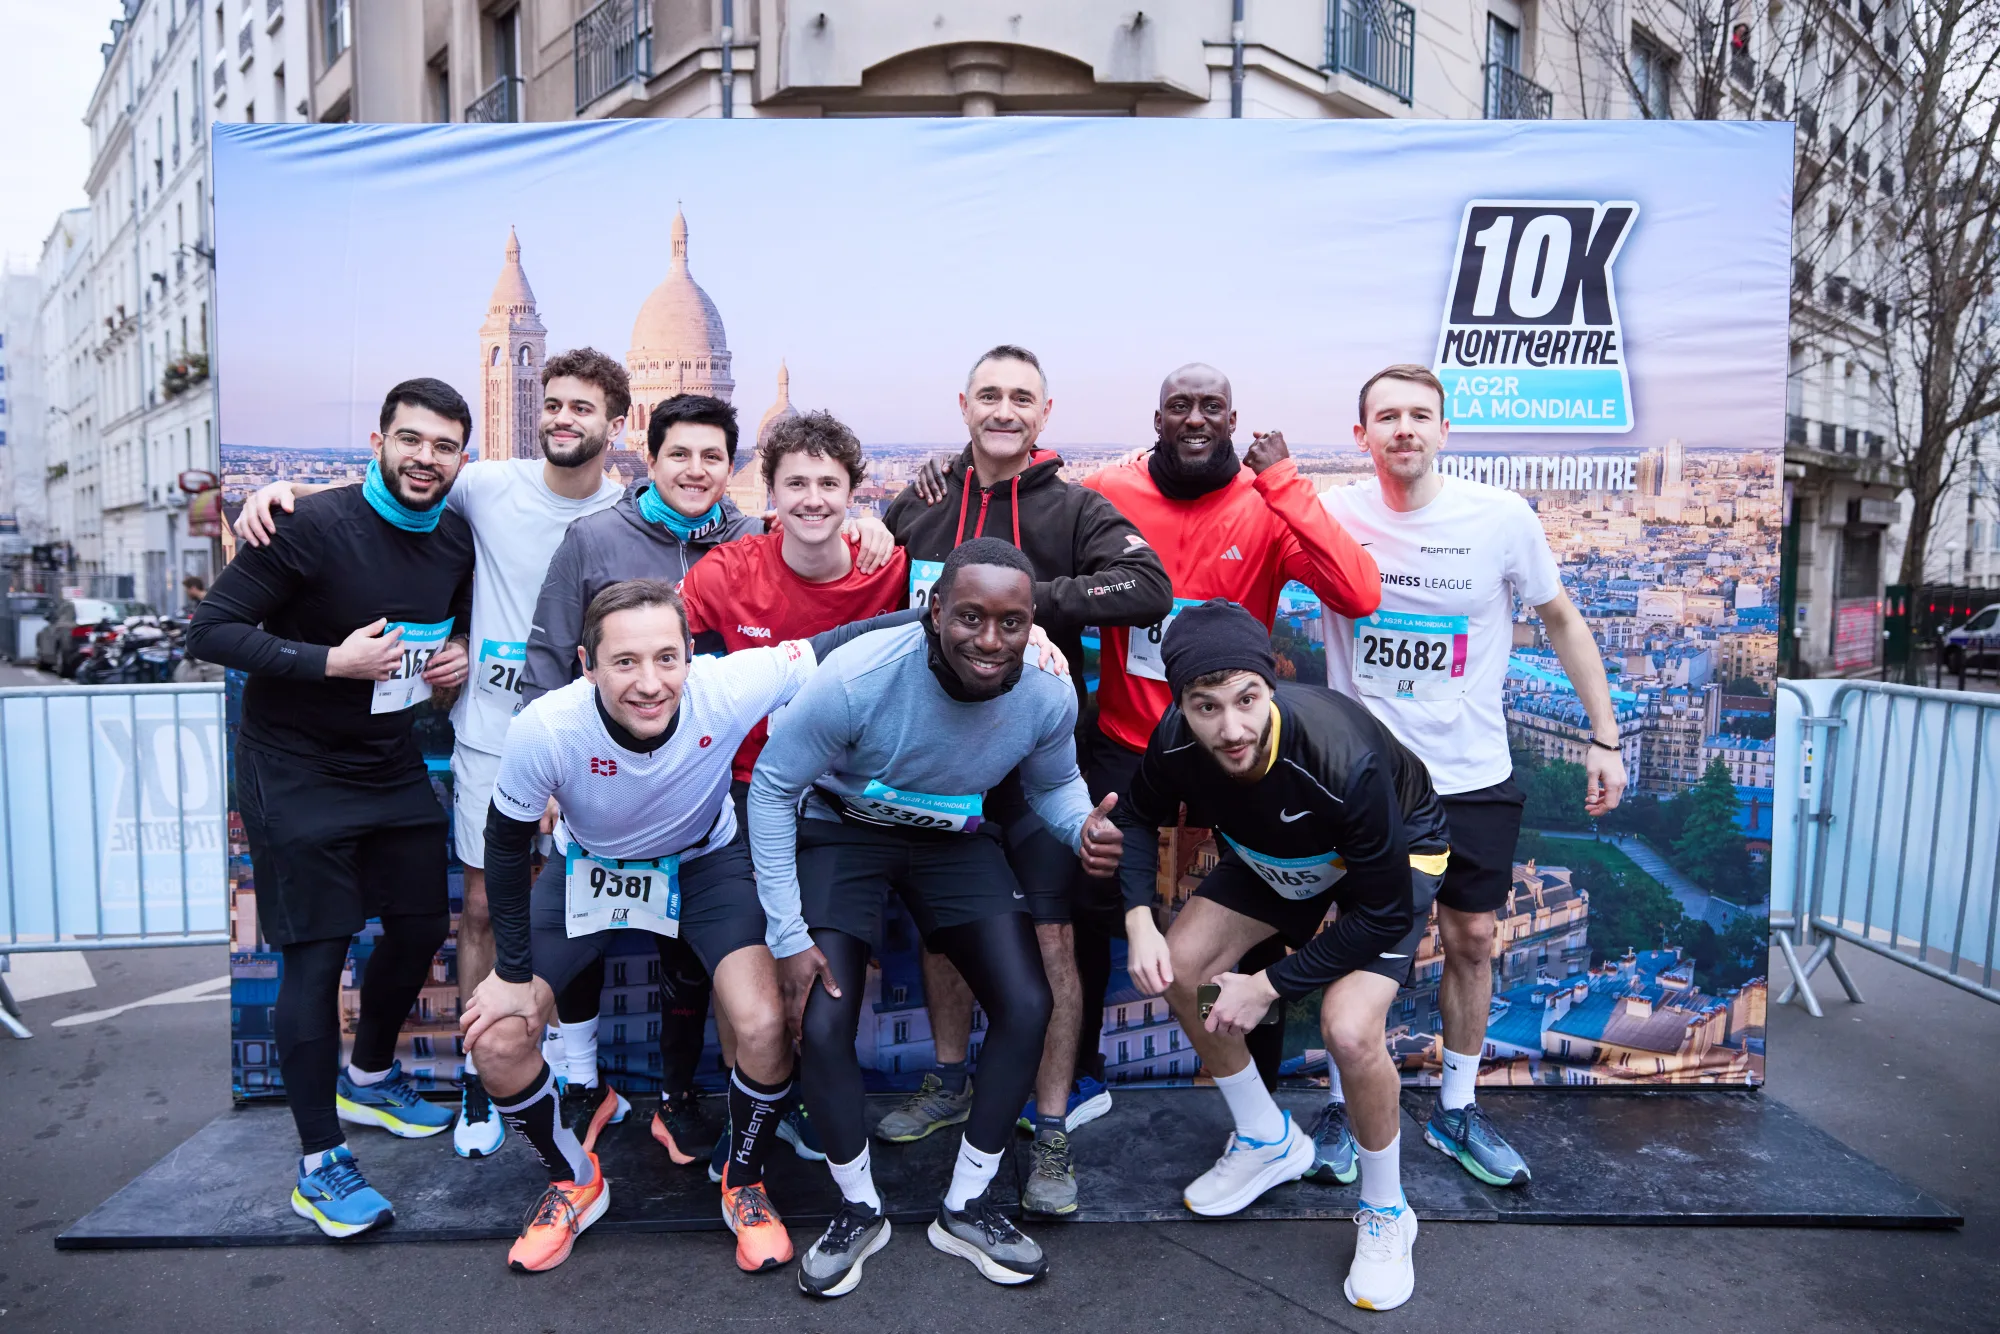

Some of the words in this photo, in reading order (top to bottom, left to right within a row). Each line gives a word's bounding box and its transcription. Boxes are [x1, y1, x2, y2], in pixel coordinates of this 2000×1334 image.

[1472, 206, 1633, 326] 10K
[1454, 376, 1519, 396] AG2R
[1453, 398, 1484, 418] LA
[1491, 399, 1616, 419] MONDIALE
[1424, 577, 1472, 590] LEAGUE
[1383, 616, 1402, 625] AG2R
[1403, 618, 1413, 626] LA
[1415, 620, 1453, 629] MONDIALE
[737, 624, 772, 639] HOKA
[1363, 634, 1447, 671] 25682
[1397, 680, 1415, 690] 10K
[933, 800, 971, 810] MONDIALE
[1253, 861, 1322, 886] 5165
[590, 867, 652, 903] 9381
[671, 893, 679, 906] MIN
[611, 908, 630, 919] 10K
[670, 907, 676, 916] 47
